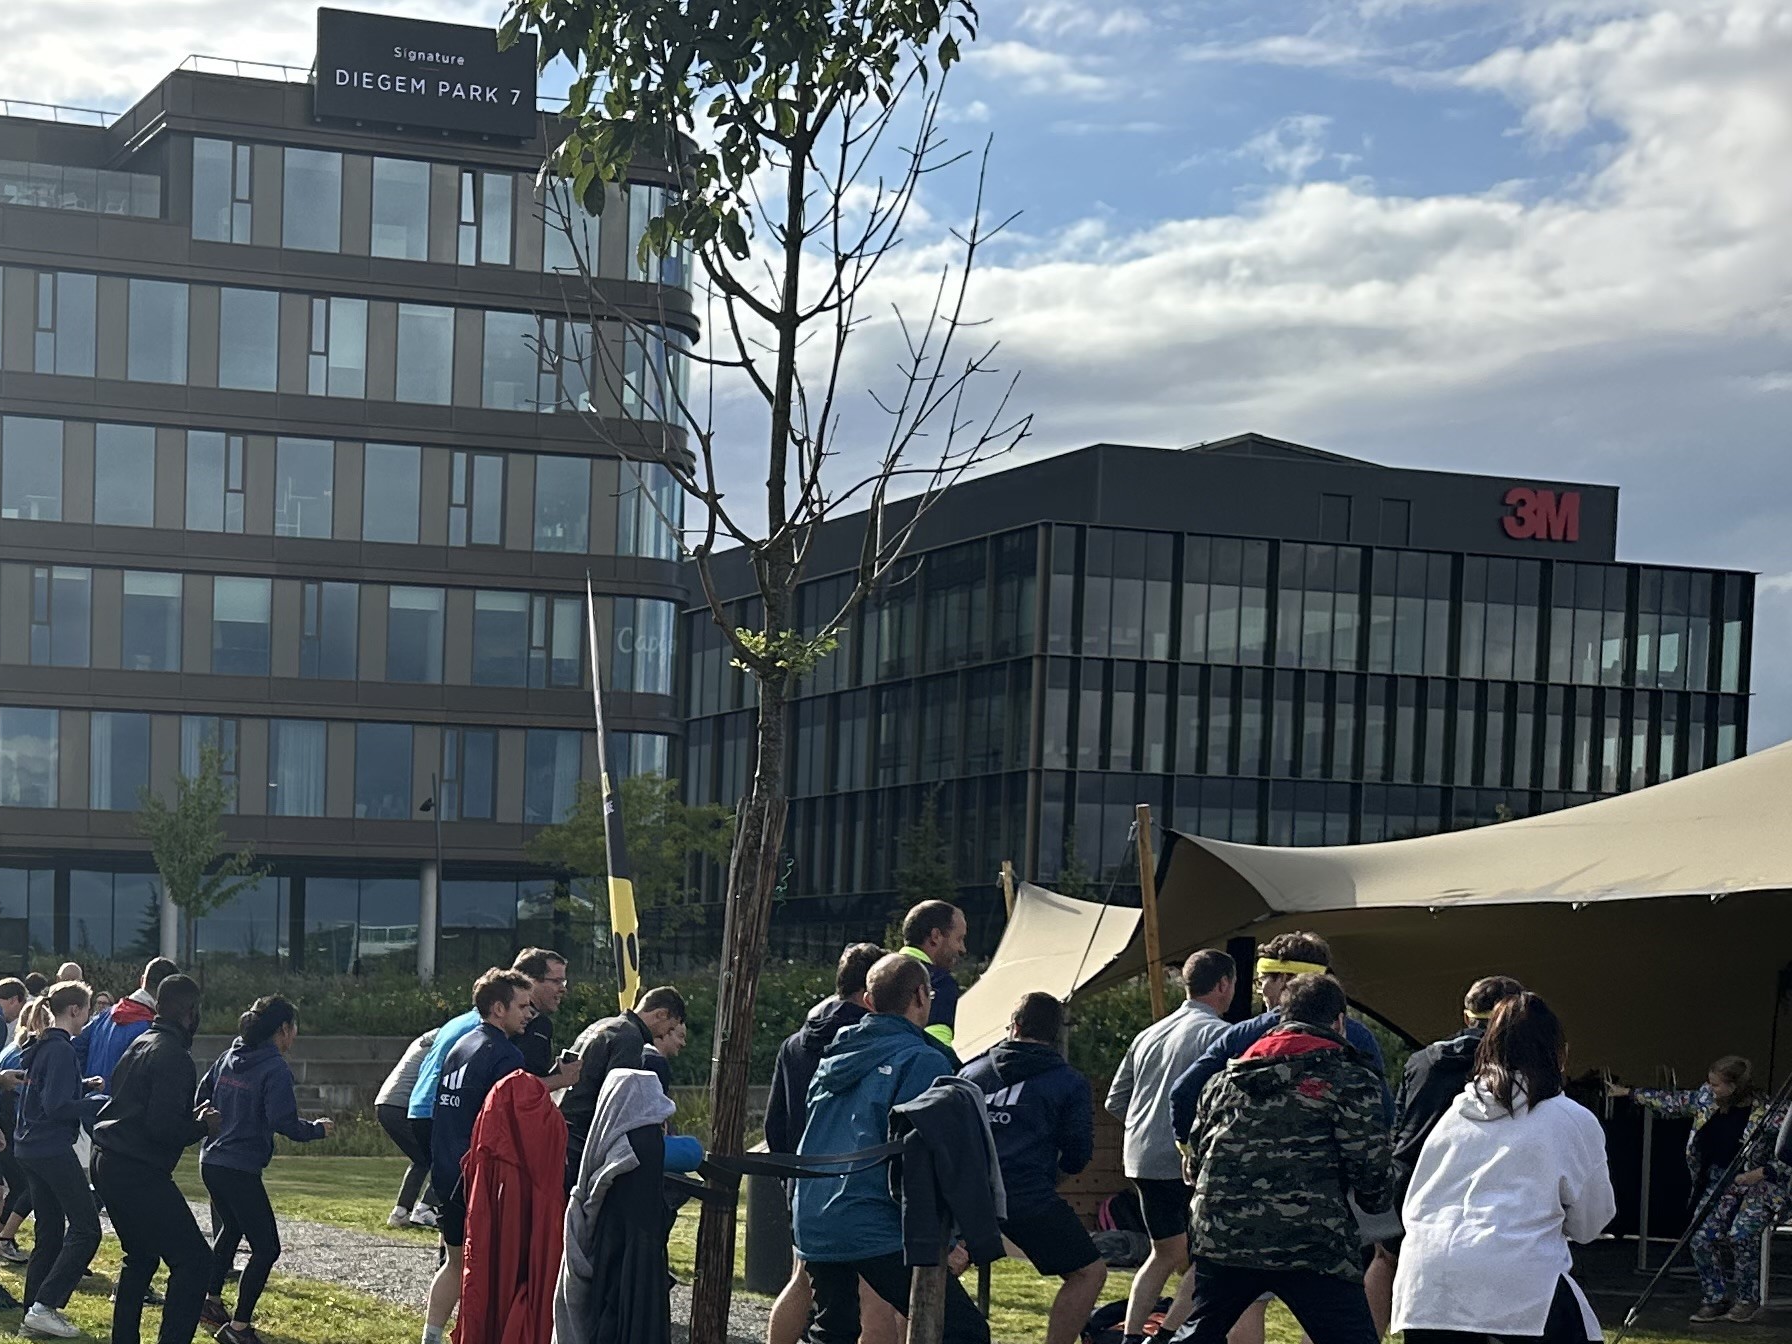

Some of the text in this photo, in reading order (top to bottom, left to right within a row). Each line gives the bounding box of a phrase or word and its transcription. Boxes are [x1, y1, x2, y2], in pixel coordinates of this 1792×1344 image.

[394, 46, 465, 66] Signature
[335, 69, 521, 105] DIEGEM PARK 7
[1503, 487, 1581, 541] 3M
